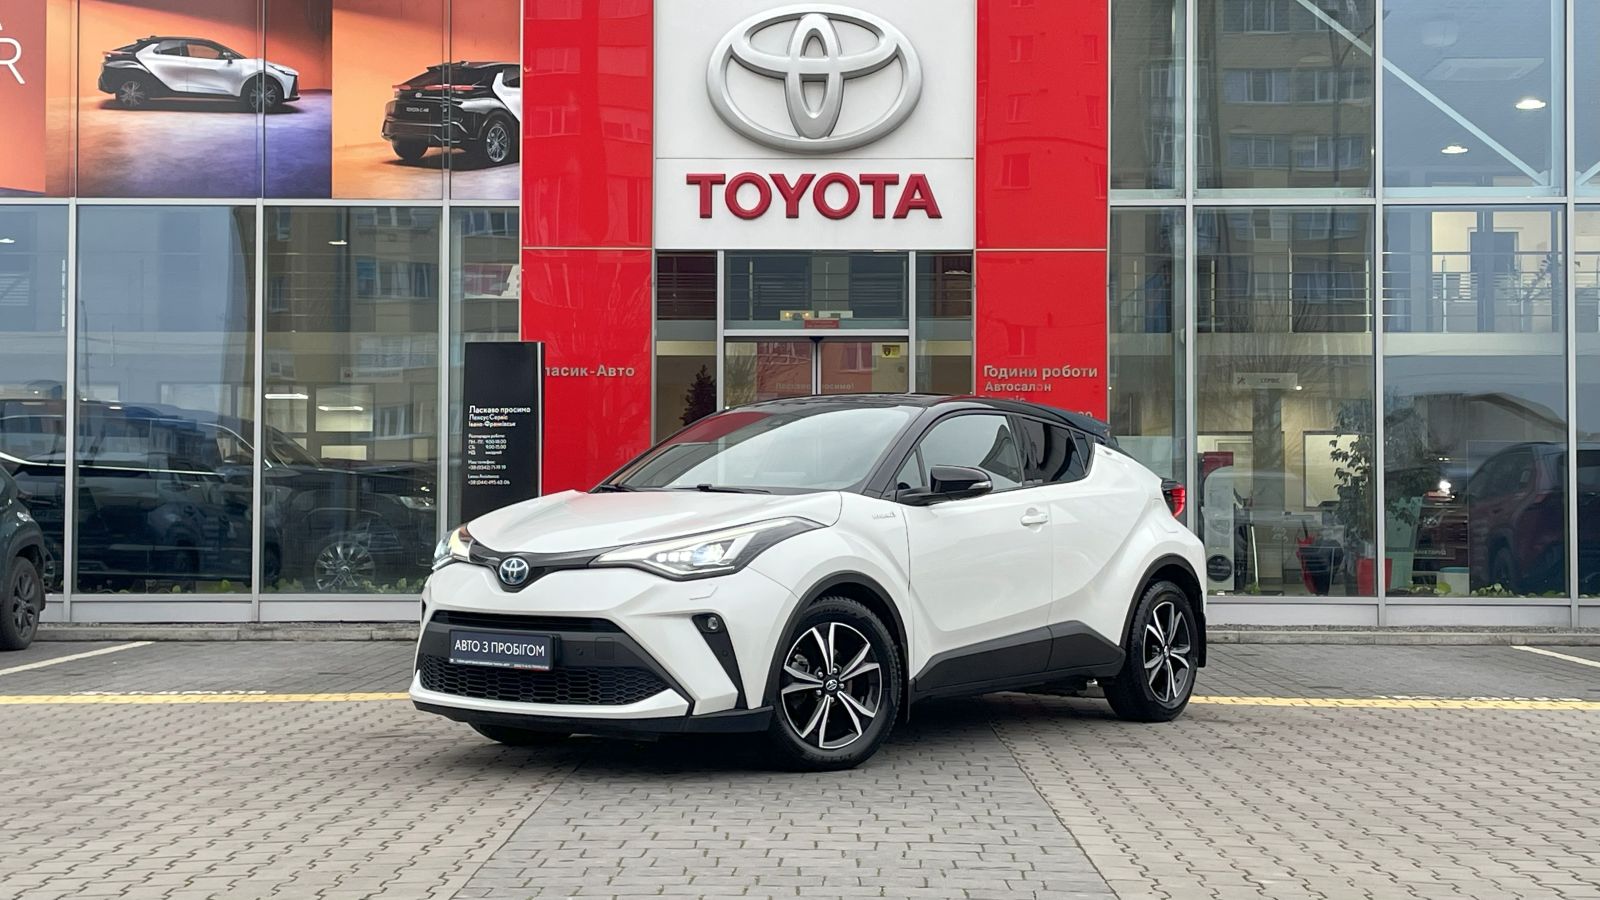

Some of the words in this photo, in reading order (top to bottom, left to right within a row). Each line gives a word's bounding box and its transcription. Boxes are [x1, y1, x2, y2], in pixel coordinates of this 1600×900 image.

[686, 172, 942, 219] TOYOTA
[983, 365, 1037, 379] Години
[1042, 365, 1098, 380] роботи
[985, 382, 1052, 392] Автосалон
[469, 405, 500, 413] Ласкаво
[454, 640, 480, 652] АВТО
[482, 641, 489, 653] З
[491, 642, 545, 657] ПРОБІГОМ
